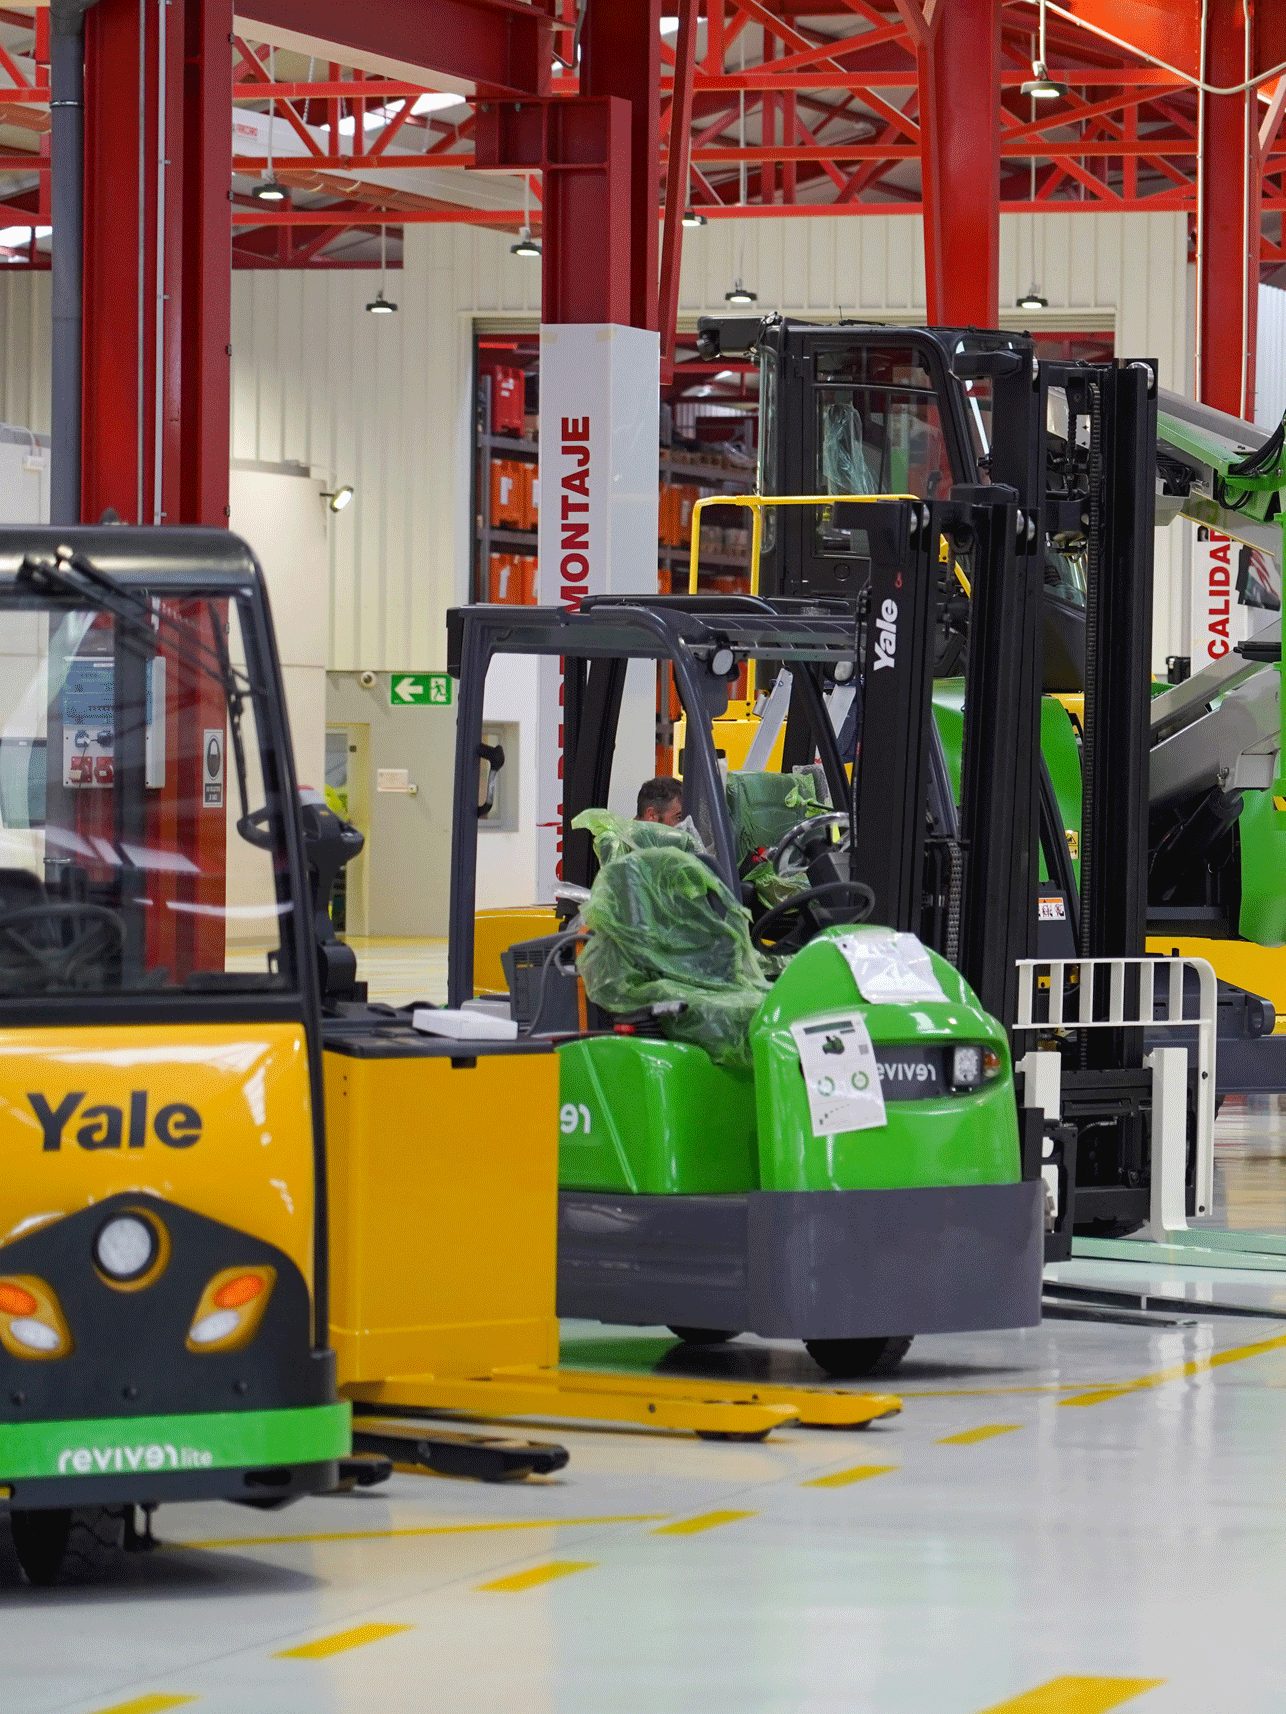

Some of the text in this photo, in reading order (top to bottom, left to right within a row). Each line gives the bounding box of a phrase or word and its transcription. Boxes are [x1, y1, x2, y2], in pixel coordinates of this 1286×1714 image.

[559, 416, 591, 614] MONTAJE
[873, 598, 898, 671] Yale
[875, 1063, 936, 1082] eviver
[27, 1091, 202, 1151] Yale
[180, 1446, 213, 1468] lite
